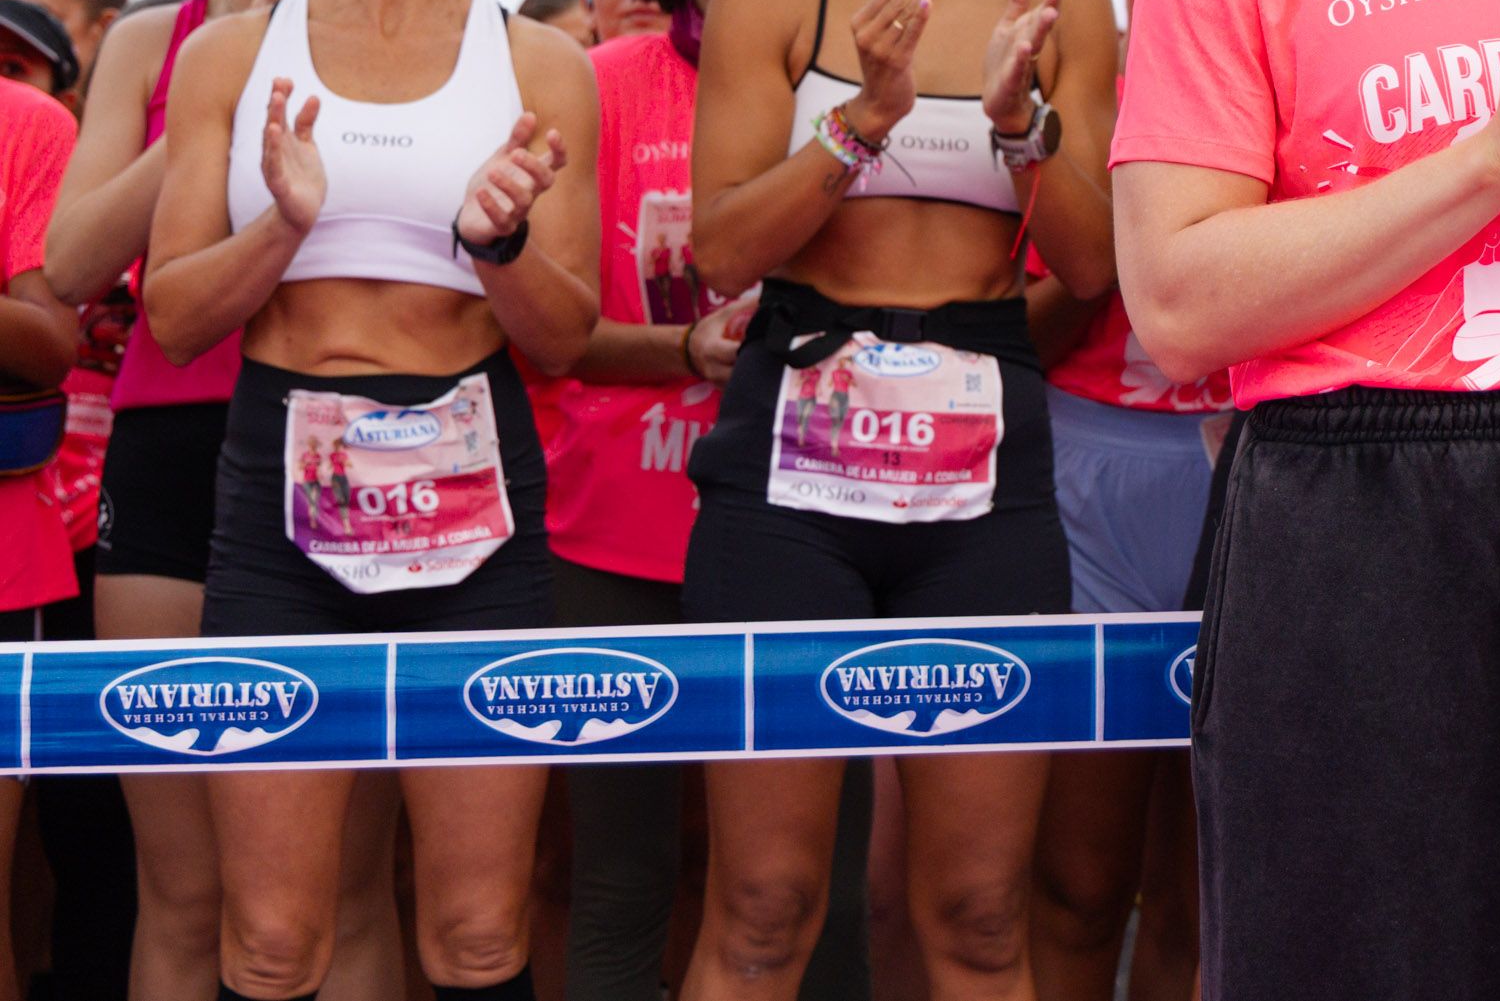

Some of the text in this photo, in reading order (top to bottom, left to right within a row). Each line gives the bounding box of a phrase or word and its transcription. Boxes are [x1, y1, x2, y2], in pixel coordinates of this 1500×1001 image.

[340, 130, 413, 149] OYSHO
[900, 134, 970, 152] OYSHO
[851, 408, 935, 446] 016
[882, 451, 901, 466] 13
[357, 479, 440, 516] 016
[480, 671, 662, 710] ASTURIANA
[835, 662, 1015, 700] ASTURIANA
[116, 681, 302, 719] ASTURIANA
[843, 692, 983, 705] CENTRAL LECHERA
[124, 710, 269, 724] CENTRAL LECHERA
[487, 702, 629, 715] CENTRAL LECHERA
